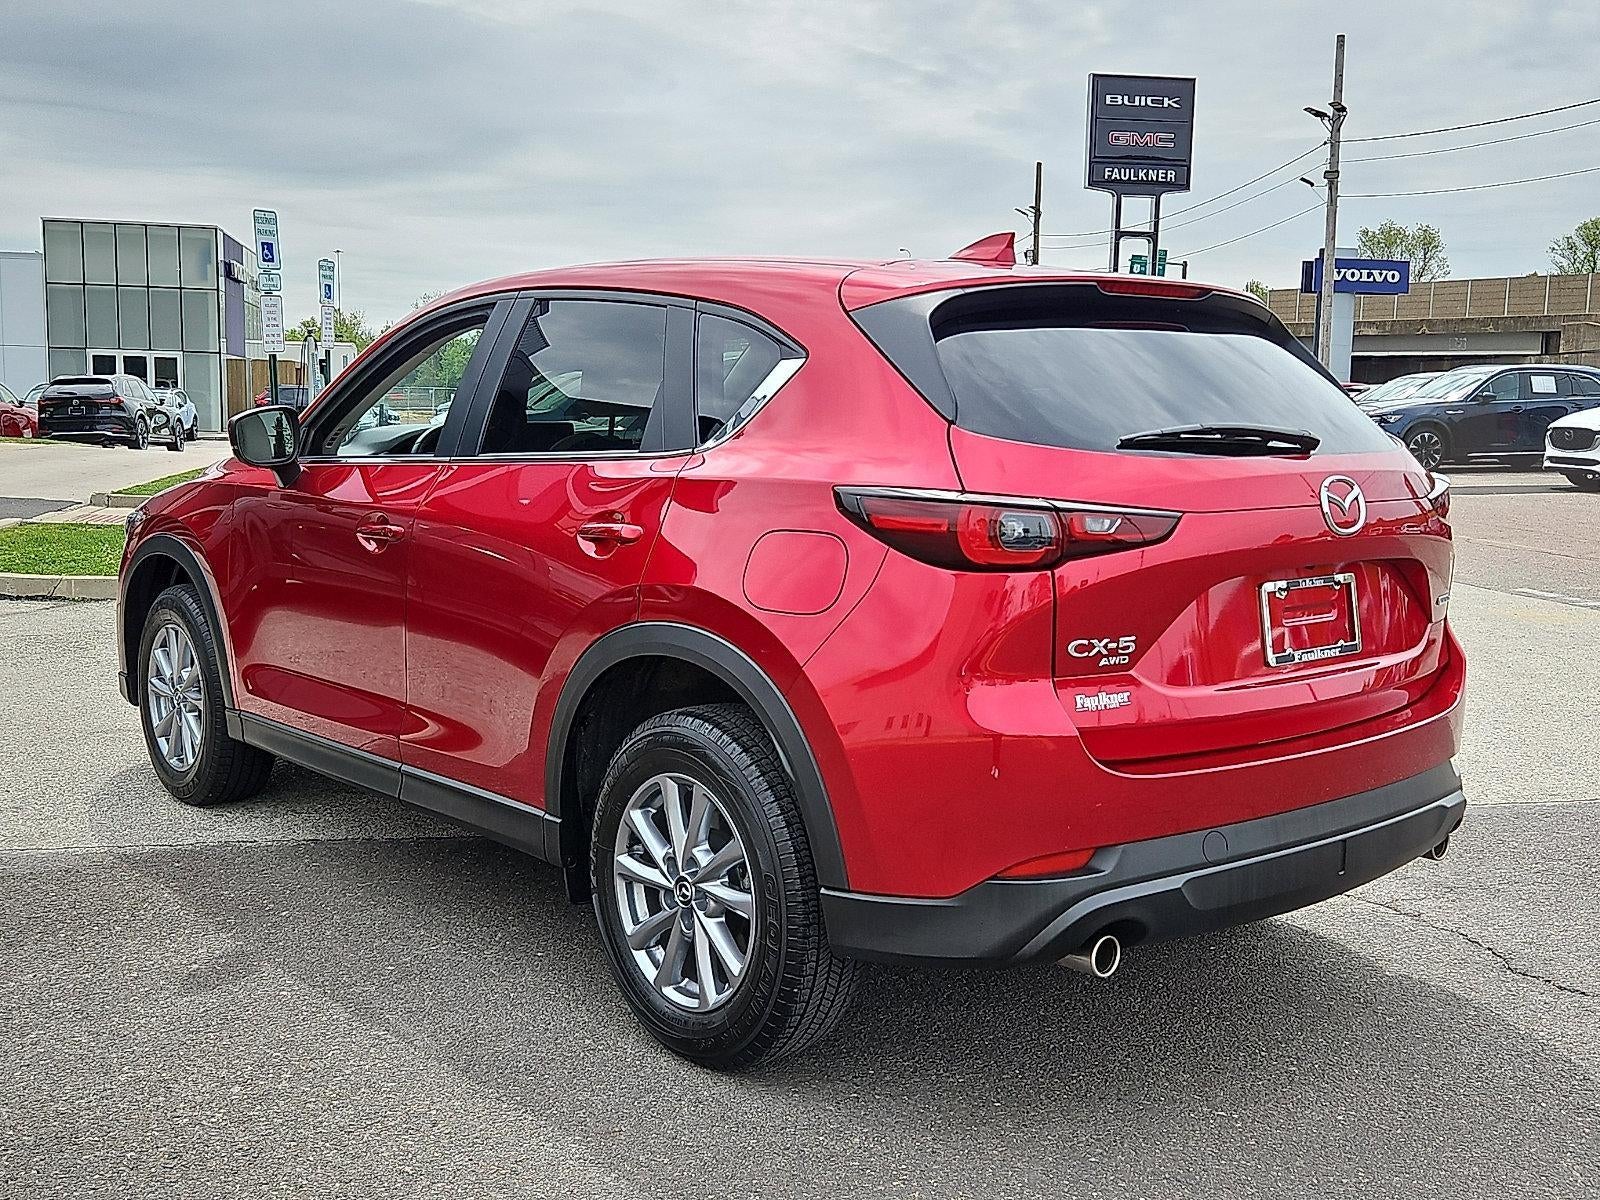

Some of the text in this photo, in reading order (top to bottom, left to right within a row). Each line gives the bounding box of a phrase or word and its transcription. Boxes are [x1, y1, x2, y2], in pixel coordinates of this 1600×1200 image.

[1105, 94, 1181, 108] BUICK
[1108, 131, 1175, 148] GMC
[1104, 167, 1176, 182] FAULKNER
[1333, 268, 1401, 283] VOLVO
[1067, 635, 1137, 658] CX-5
[1098, 655, 1129, 667] AWD
[1294, 647, 1341, 662] Faulkner
[1074, 691, 1131, 709] Faulkner
